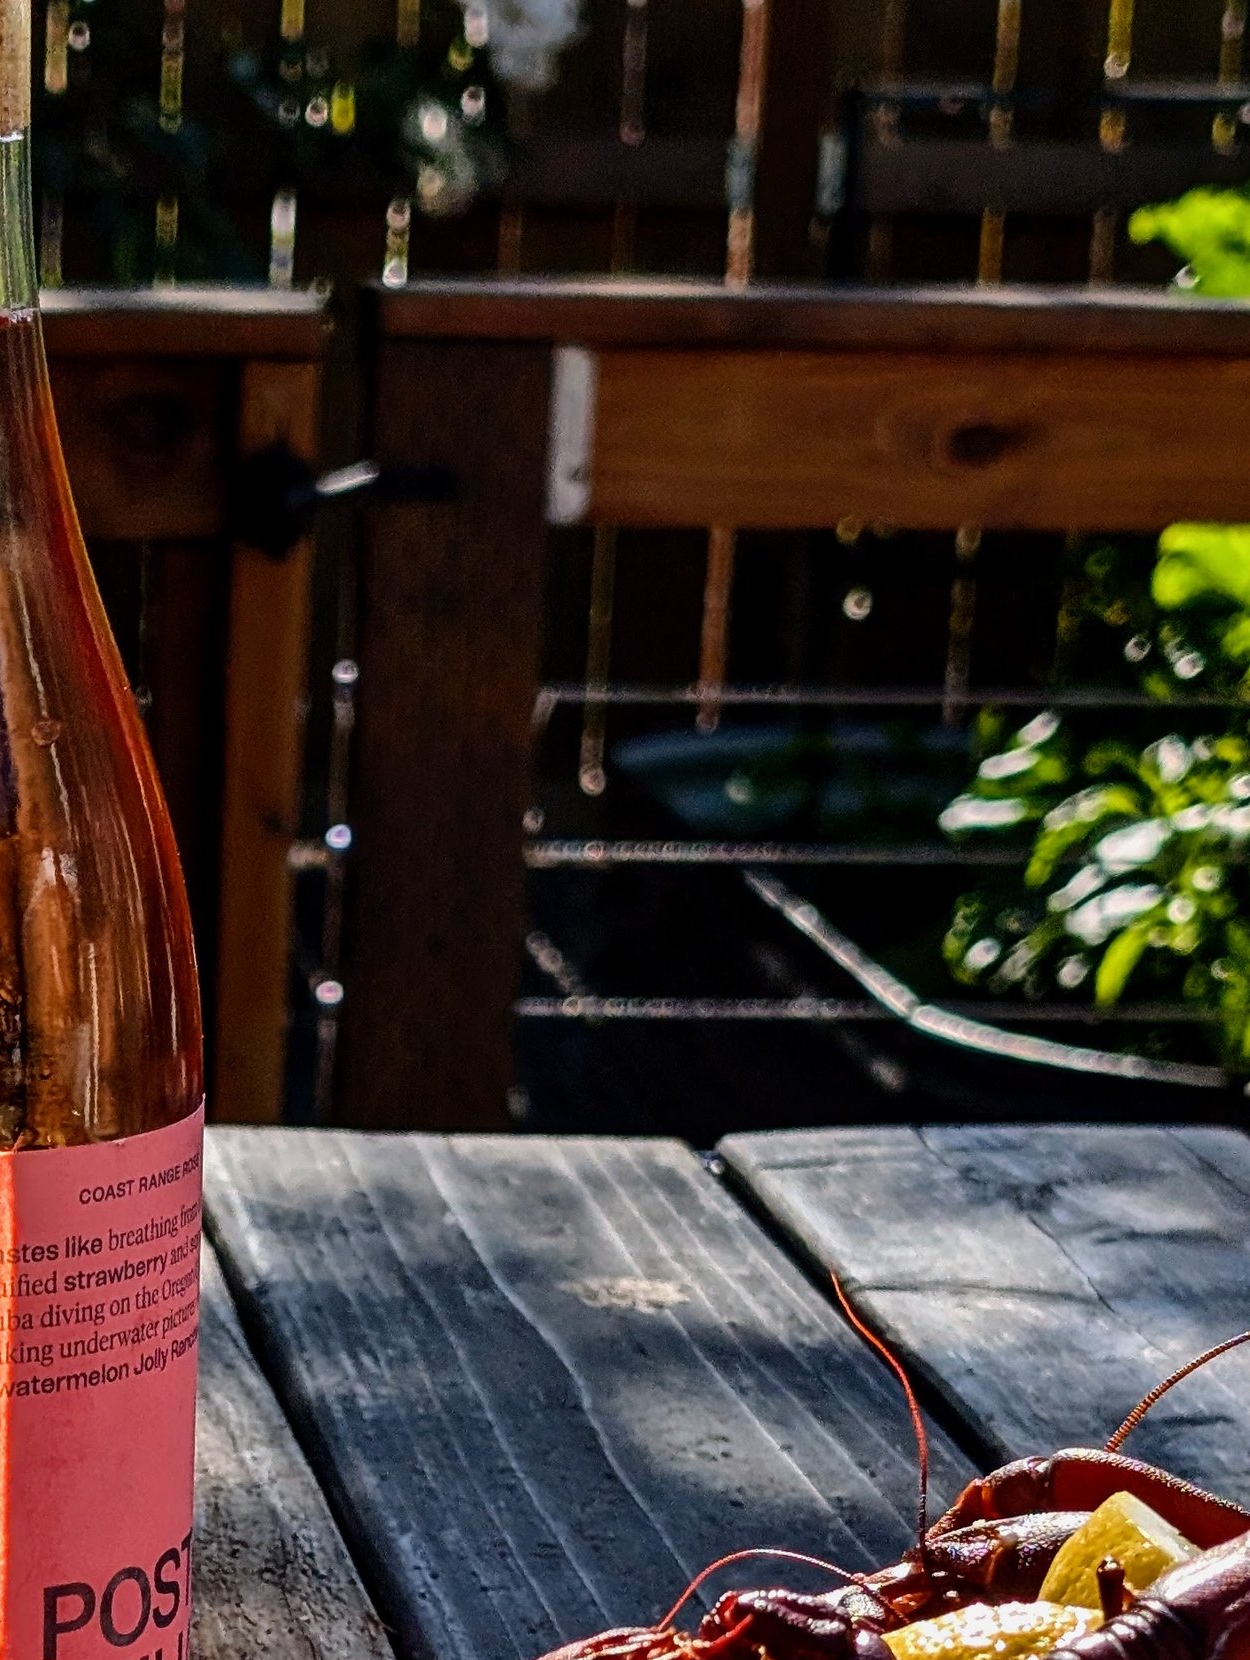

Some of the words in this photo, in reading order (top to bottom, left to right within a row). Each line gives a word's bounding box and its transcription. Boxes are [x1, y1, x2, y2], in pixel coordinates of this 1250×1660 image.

[78, 1179, 135, 1204] COAST
[138, 1165, 181, 1193] RANGE
[65, 1235, 103, 1258] like
[108, 1215, 179, 1251] breathing
[64, 1252, 168, 1292] strawberry
[170, 1235, 189, 1265] and
[40, 1302, 106, 1329] diving
[110, 1296, 130, 1316] on
[135, 1286, 159, 1310] the
[60, 1320, 160, 1357] underwater
[134, 1346, 169, 1375] Jolly
